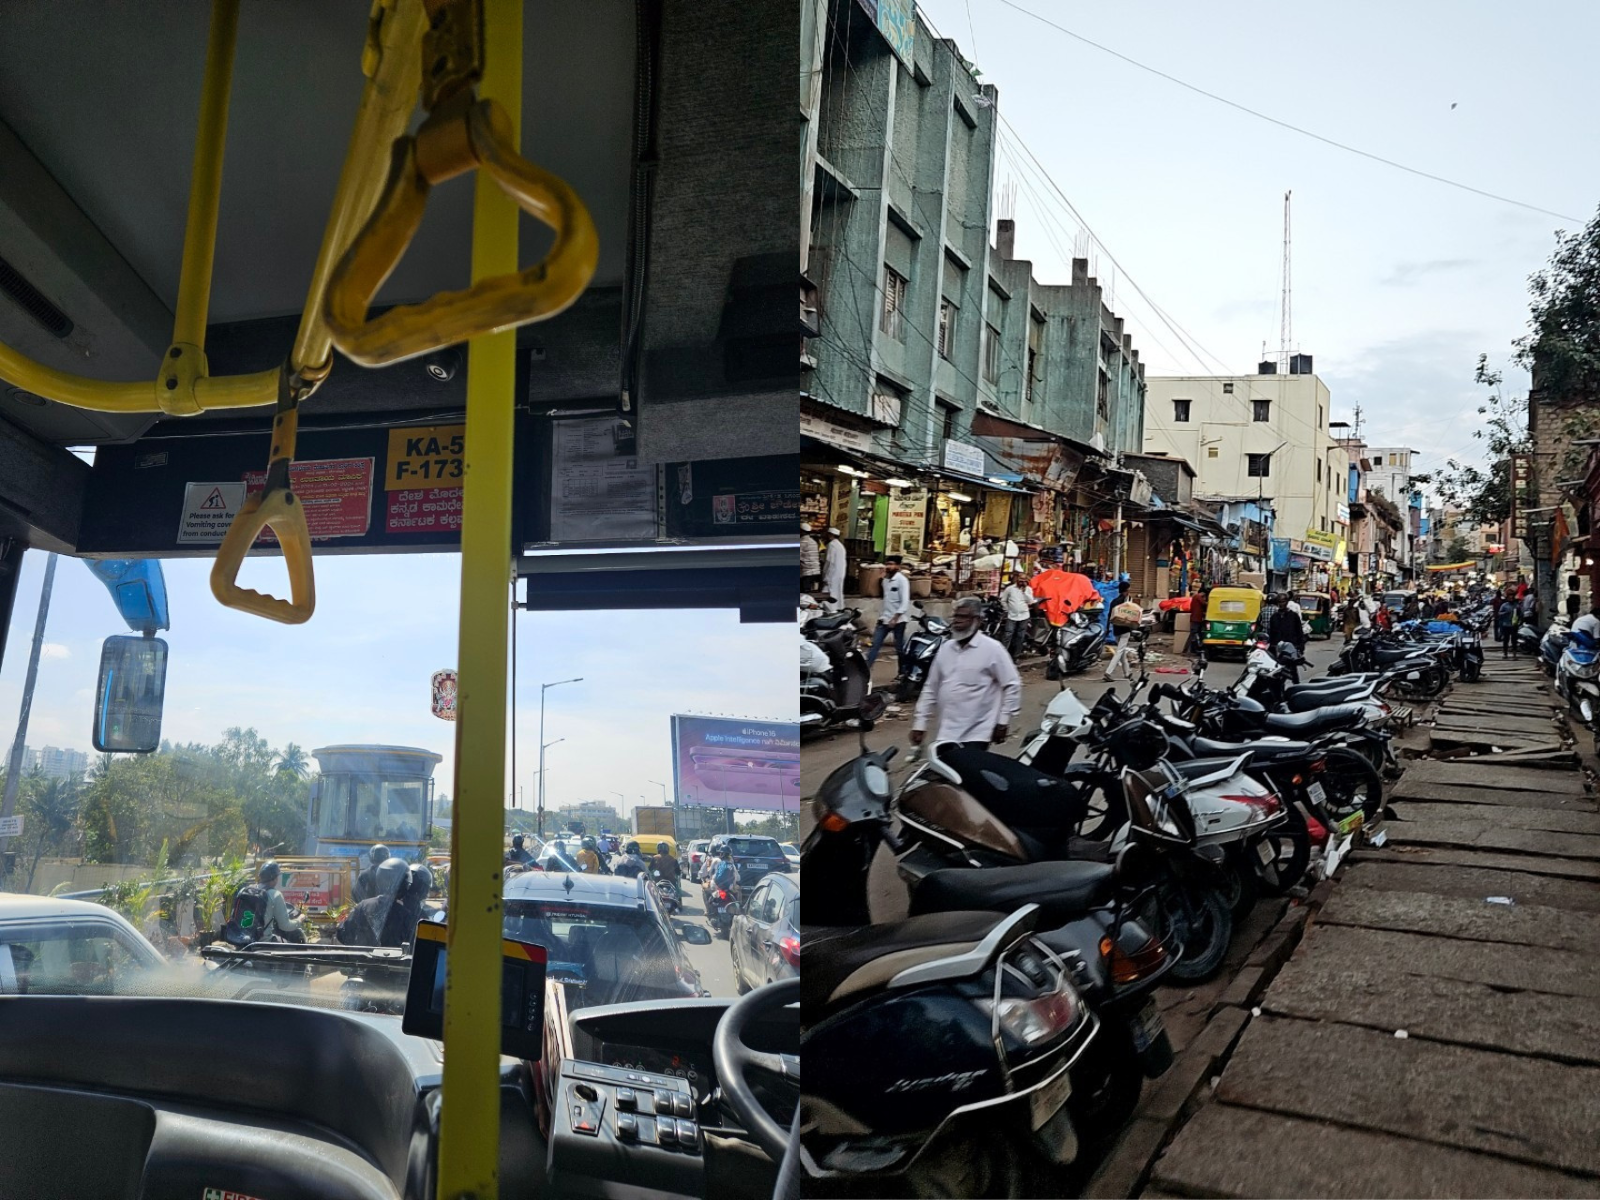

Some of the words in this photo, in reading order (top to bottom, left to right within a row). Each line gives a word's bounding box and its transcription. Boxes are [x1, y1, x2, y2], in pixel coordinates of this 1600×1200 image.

[398, 490, 424, 501] ದೇಶ
[390, 502, 418, 517] ಕನ್ನಡ
[186, 521, 216, 529] Vomiting
[389, 514, 435, 527] ಕರ್ನಾಟಕ
[747, 728, 768, 737] iPhone
[705, 733, 723, 743] Apple
[724, 735, 760, 745] Intelligence
